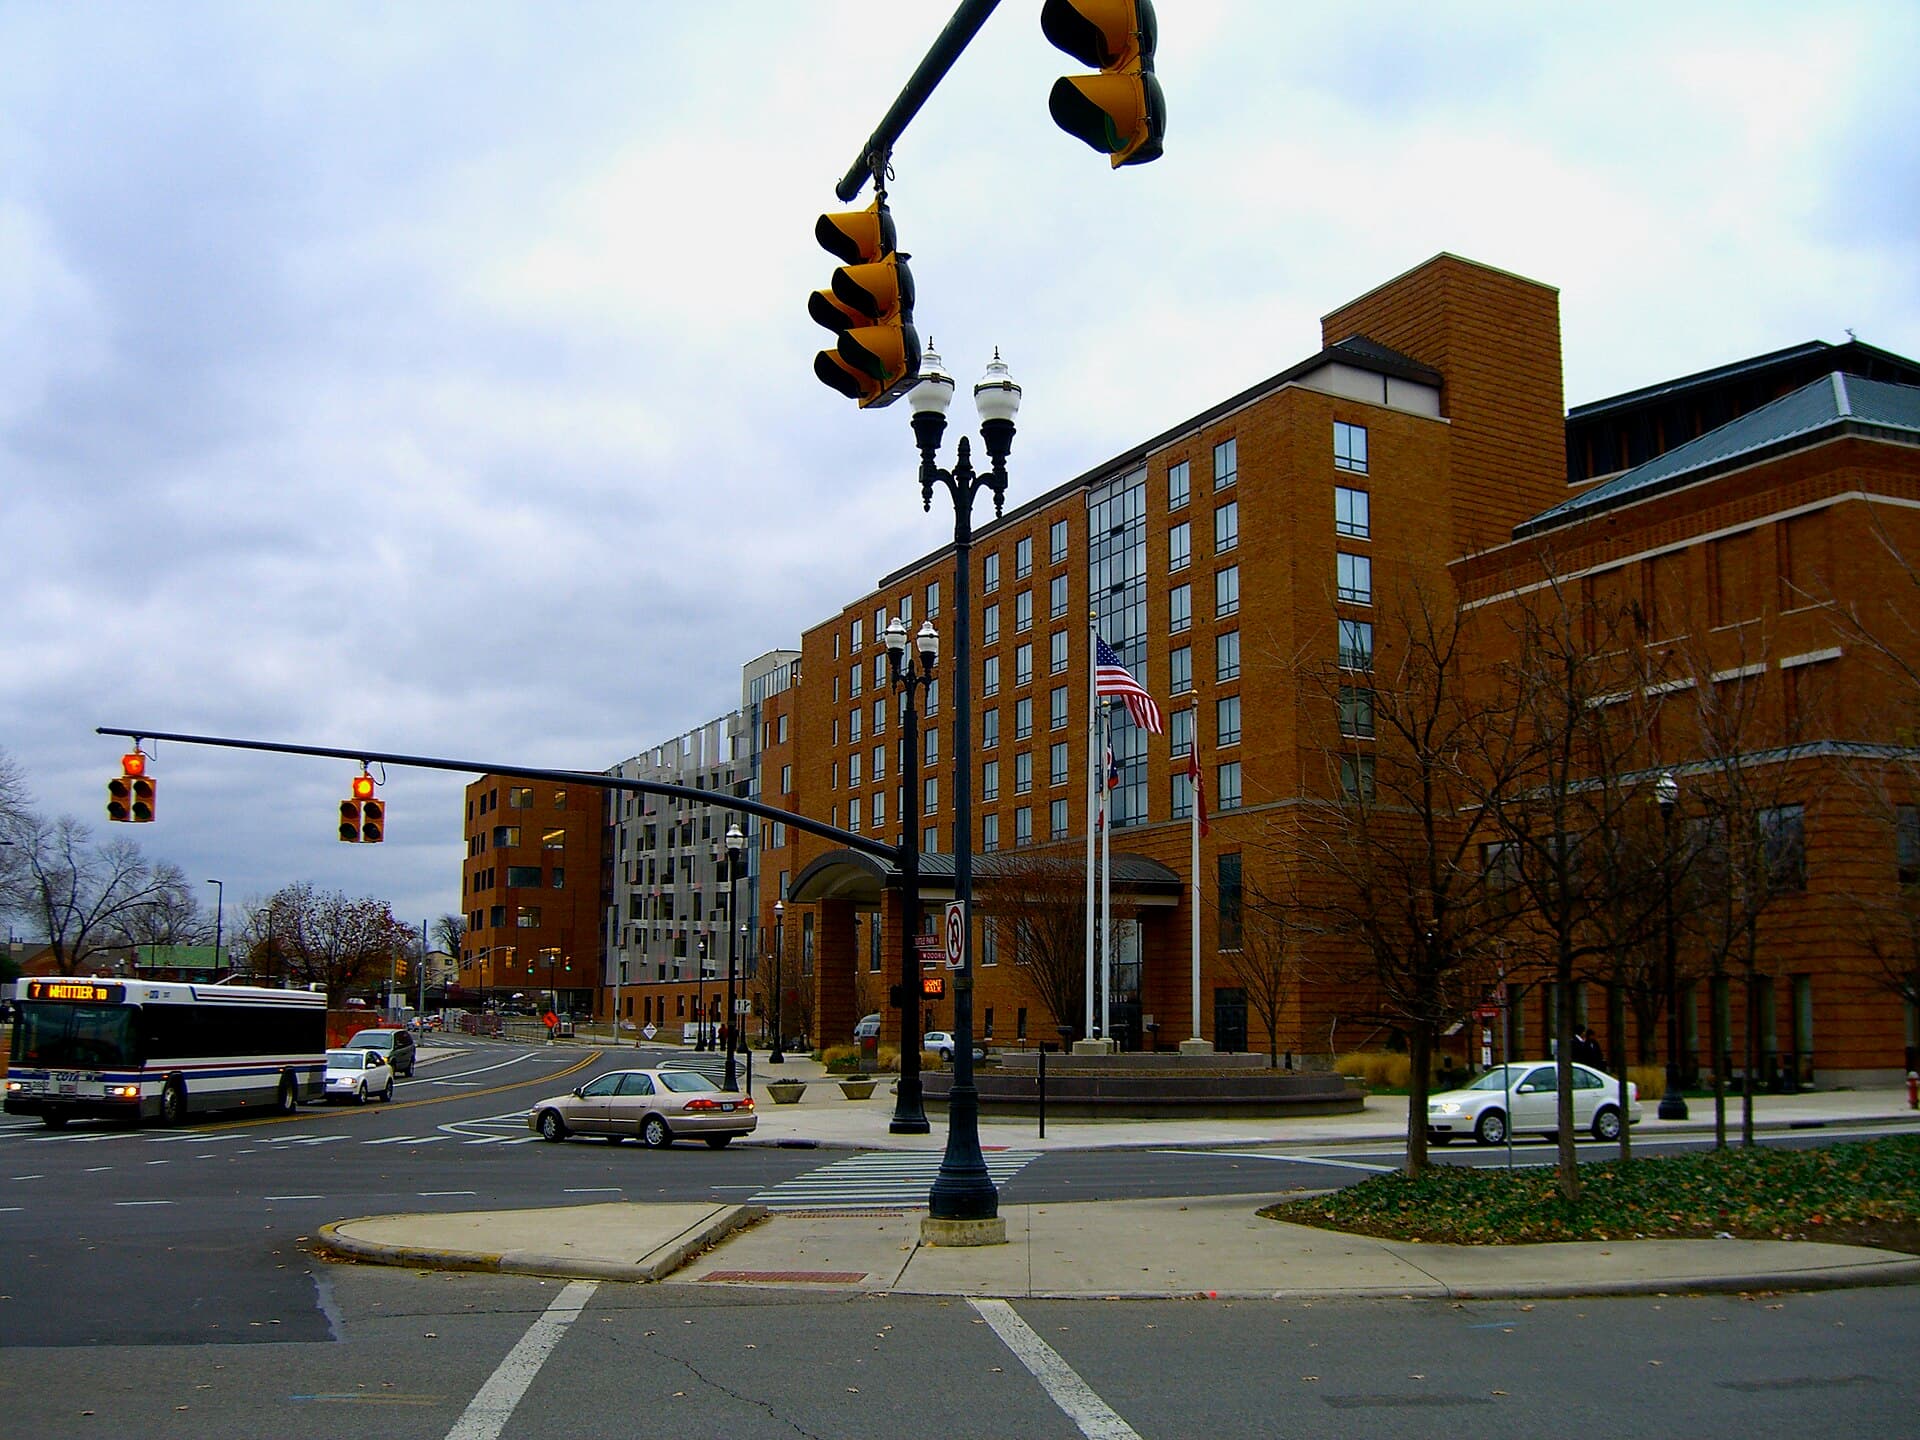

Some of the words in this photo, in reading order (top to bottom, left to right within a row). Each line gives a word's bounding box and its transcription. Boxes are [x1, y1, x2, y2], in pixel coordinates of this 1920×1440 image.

[33, 984, 41, 998] 7
[49, 985, 93, 999] WHITTIER
[924, 985, 943, 993] WALK
